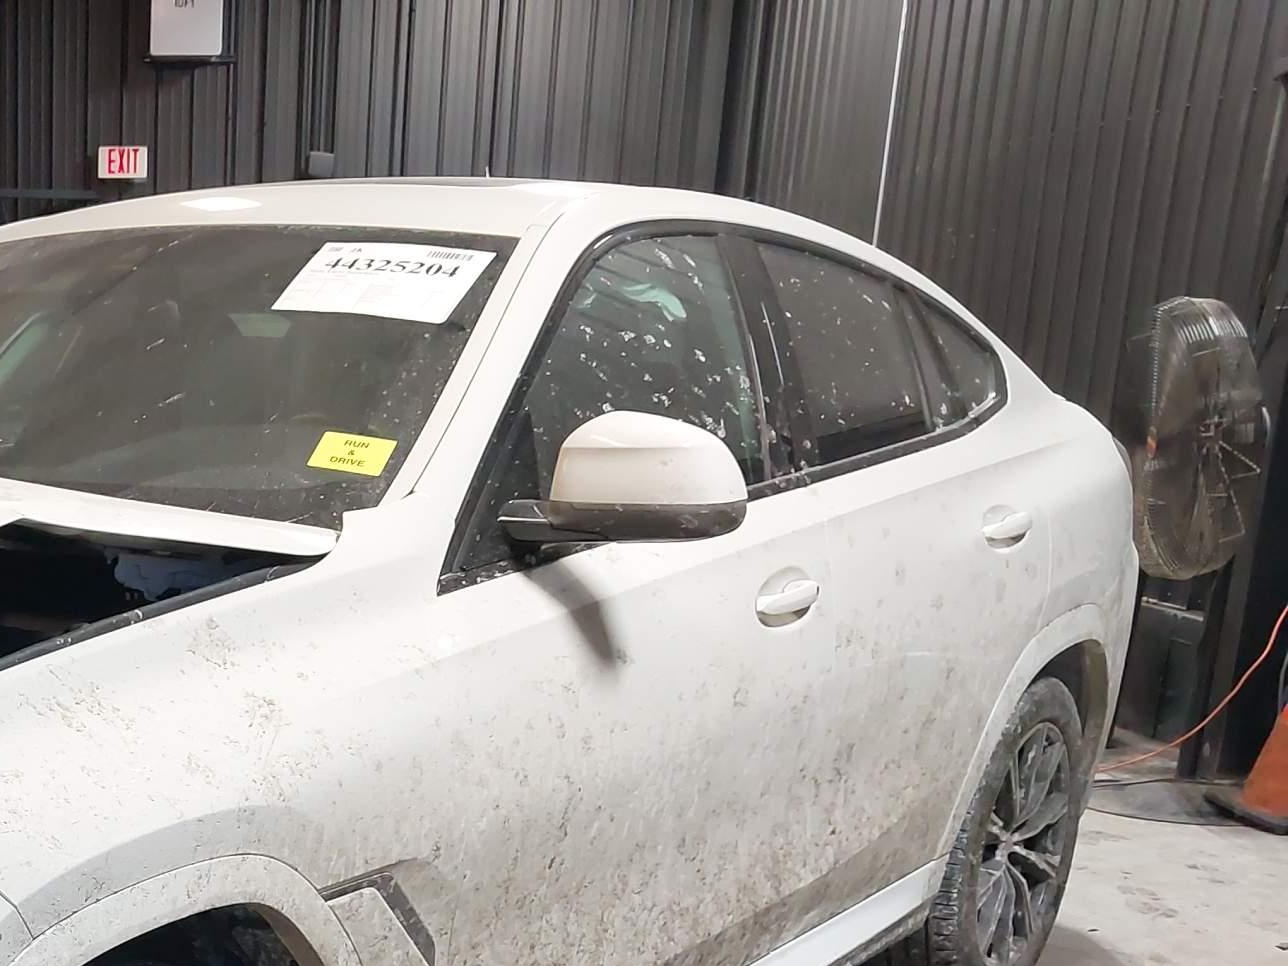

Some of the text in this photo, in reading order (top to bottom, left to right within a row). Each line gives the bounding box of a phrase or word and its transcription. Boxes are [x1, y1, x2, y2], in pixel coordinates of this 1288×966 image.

[107, 148, 140, 174] EXIT
[325, 256, 461, 278] 44325204
[343, 439, 371, 449] RUN
[347, 448, 356, 456] &
[329, 455, 366, 467] DRIVE
